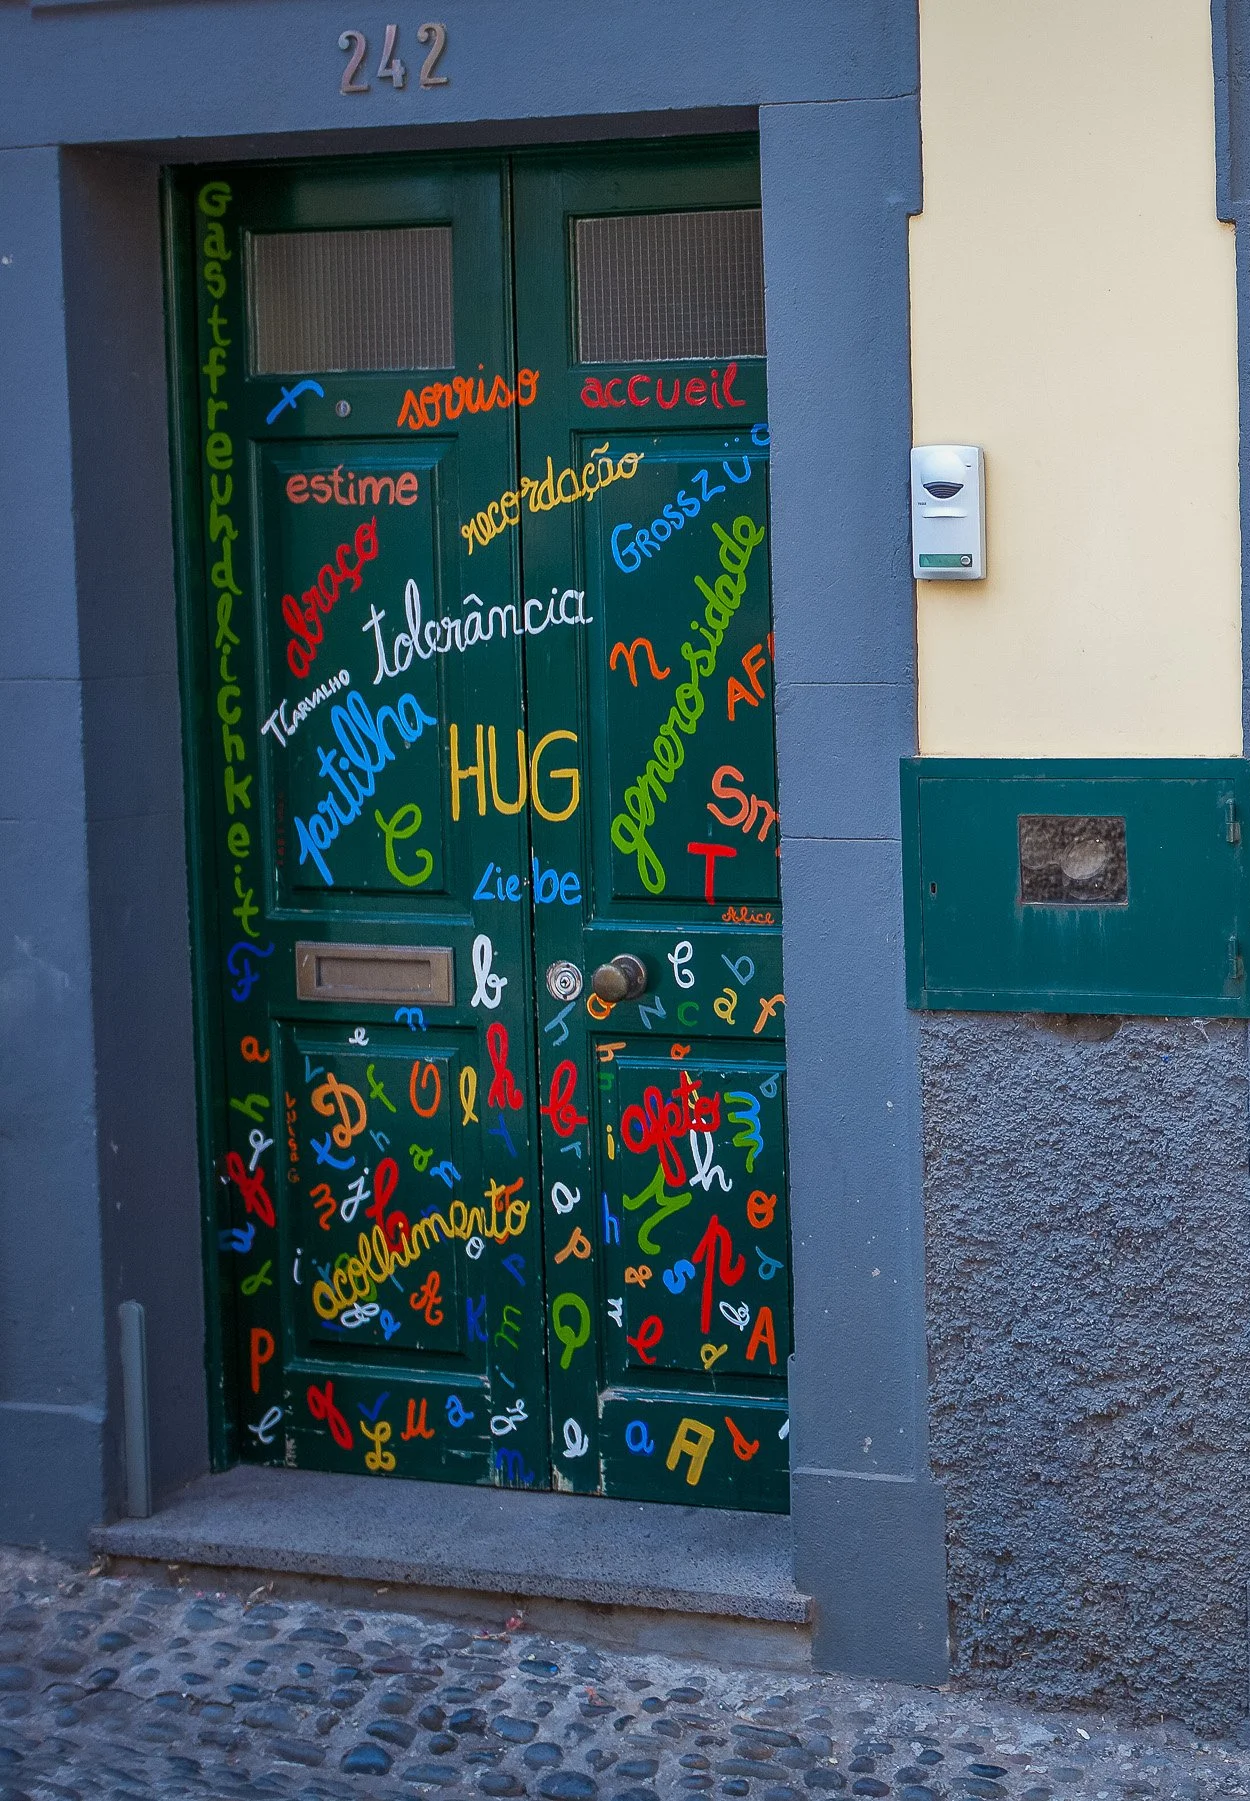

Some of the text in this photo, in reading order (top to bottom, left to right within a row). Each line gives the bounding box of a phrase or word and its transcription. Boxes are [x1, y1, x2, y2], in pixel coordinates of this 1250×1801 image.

[338, 22, 448, 95] 242
[397, 363, 540, 431] sorriso
[580, 362, 746, 410] accueil
[286, 463, 419, 507] estime
[461, 442, 645, 556] recordação
[281, 515, 380, 680] abraço
[362, 578, 593, 685] tolerância
[610, 515, 765, 895] generosidade
[293, 690, 437, 886] partilha
[450, 724, 581, 823] HUG
[473, 857, 582, 905] Liebe
[687, 841, 737, 905] T
[746, 1307, 777, 1366] A
